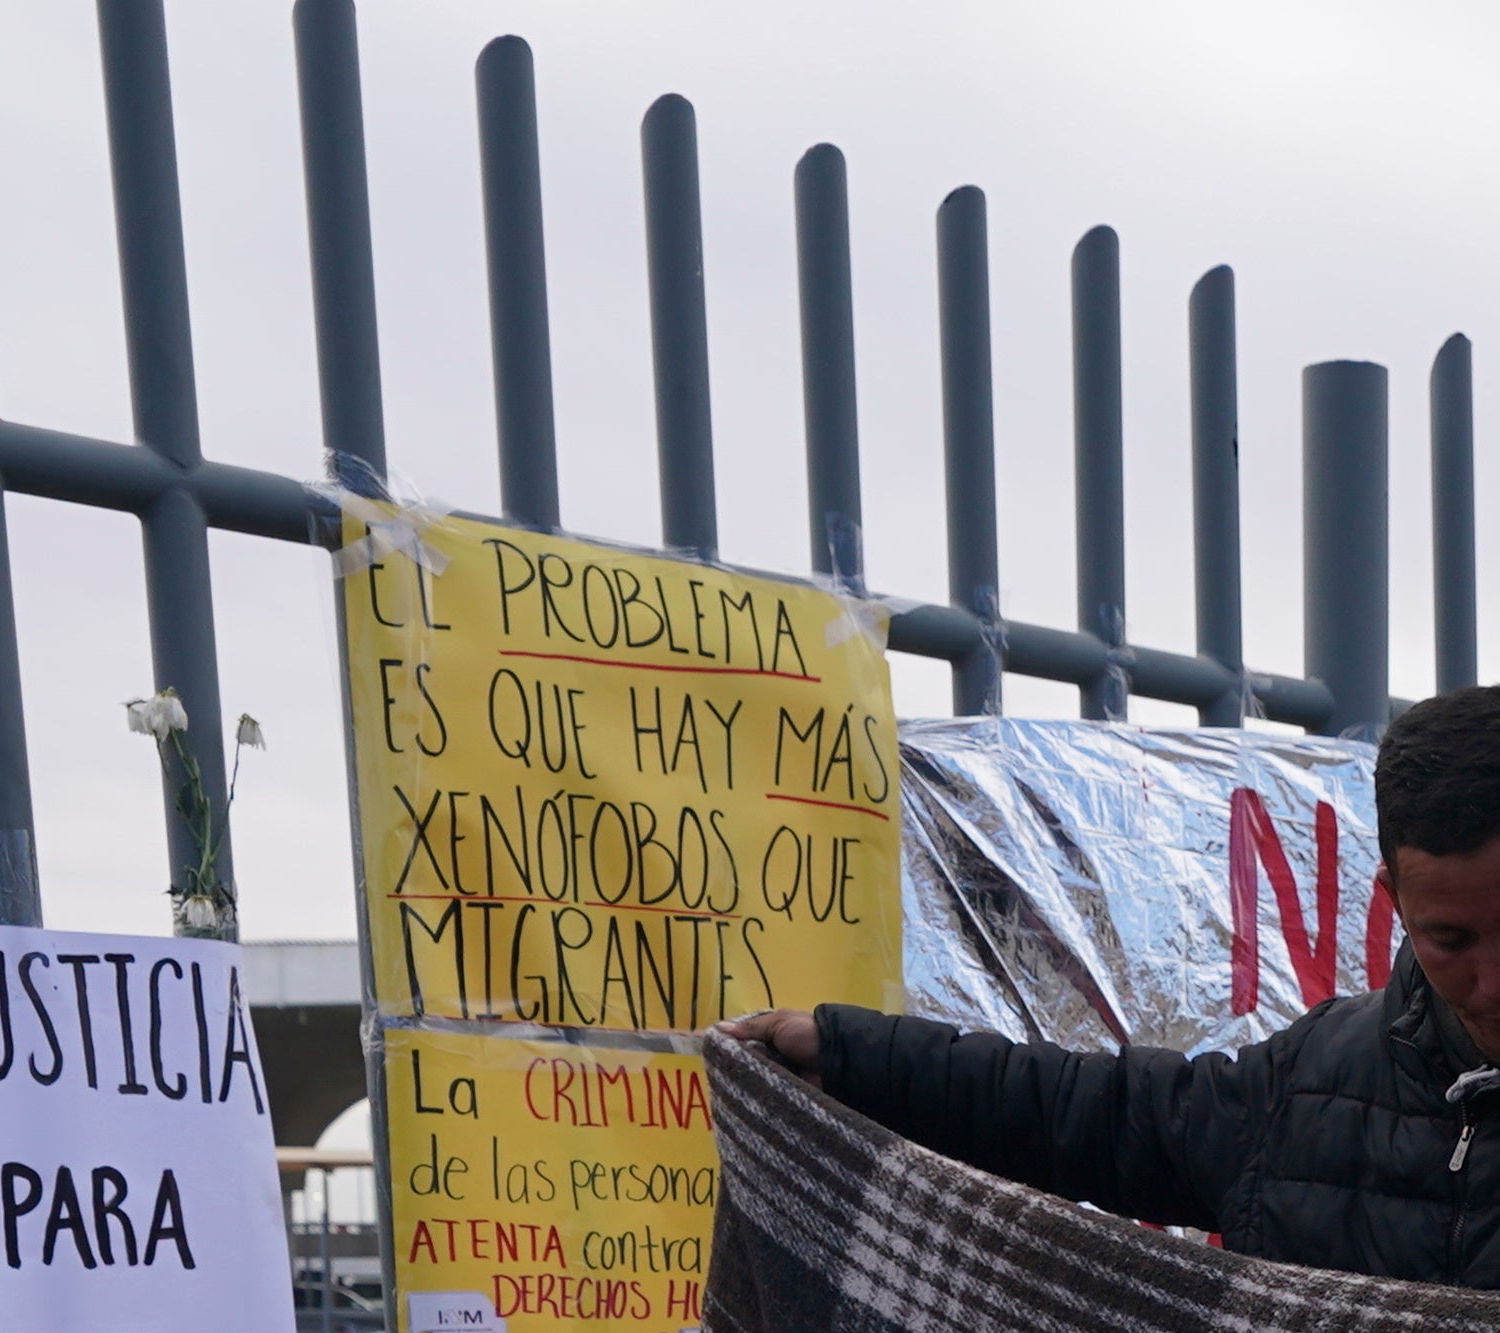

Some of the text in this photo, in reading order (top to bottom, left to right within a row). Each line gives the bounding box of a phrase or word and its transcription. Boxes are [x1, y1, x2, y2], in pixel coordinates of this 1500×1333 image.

[366, 524, 808, 677] EL PROBLEMA
[380, 659, 889, 804] ES QUE HAY MÁS
[393, 784, 863, 924] XENÓFOBOS QUE
[400, 898, 774, 1031] MIGRANTES
[411, 1048, 479, 1120] La
[0, 1162, 196, 1271] PARA
[409, 1133, 469, 1201] de
[491, 1135, 556, 1205] las
[408, 1218, 701, 1275] ATENTA contra
[492, 1273, 651, 1321] DERECHOS
